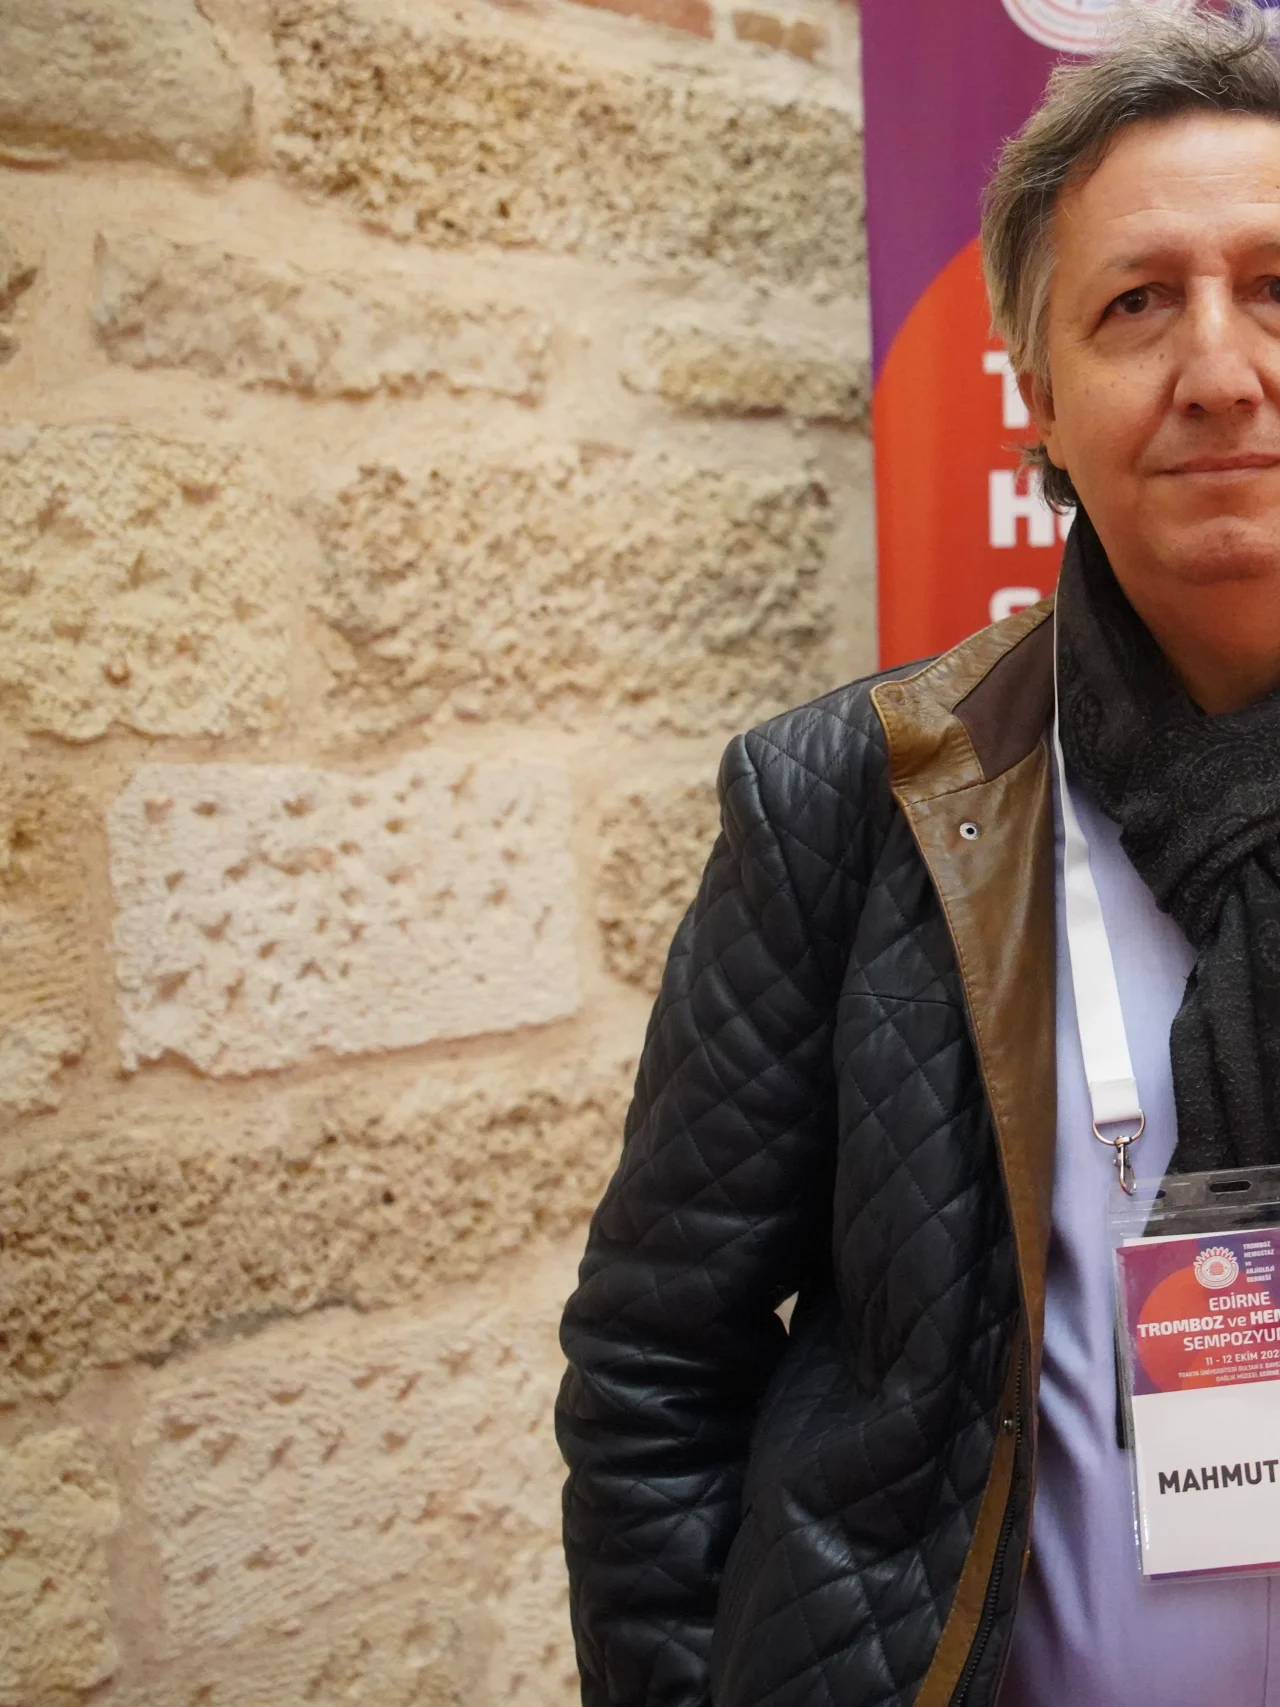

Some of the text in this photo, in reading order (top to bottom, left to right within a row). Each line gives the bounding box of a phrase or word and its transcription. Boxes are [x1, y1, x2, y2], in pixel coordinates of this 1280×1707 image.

[1243, 1240, 1271, 1250] TROMBOZ
[1243, 1248, 1275, 1258] HEMOSTAZ
[1208, 1291, 1271, 1312] EDİRNE
[1136, 1315, 1225, 1338] TROMBOZ
[1227, 1315, 1247, 1328] ve
[1205, 1356, 1214, 1366] 11
[1222, 1354, 1233, 1364] 12
[1235, 1350, 1258, 1363] EKİM
[1158, 1459, 1279, 1495] MAHMUT
